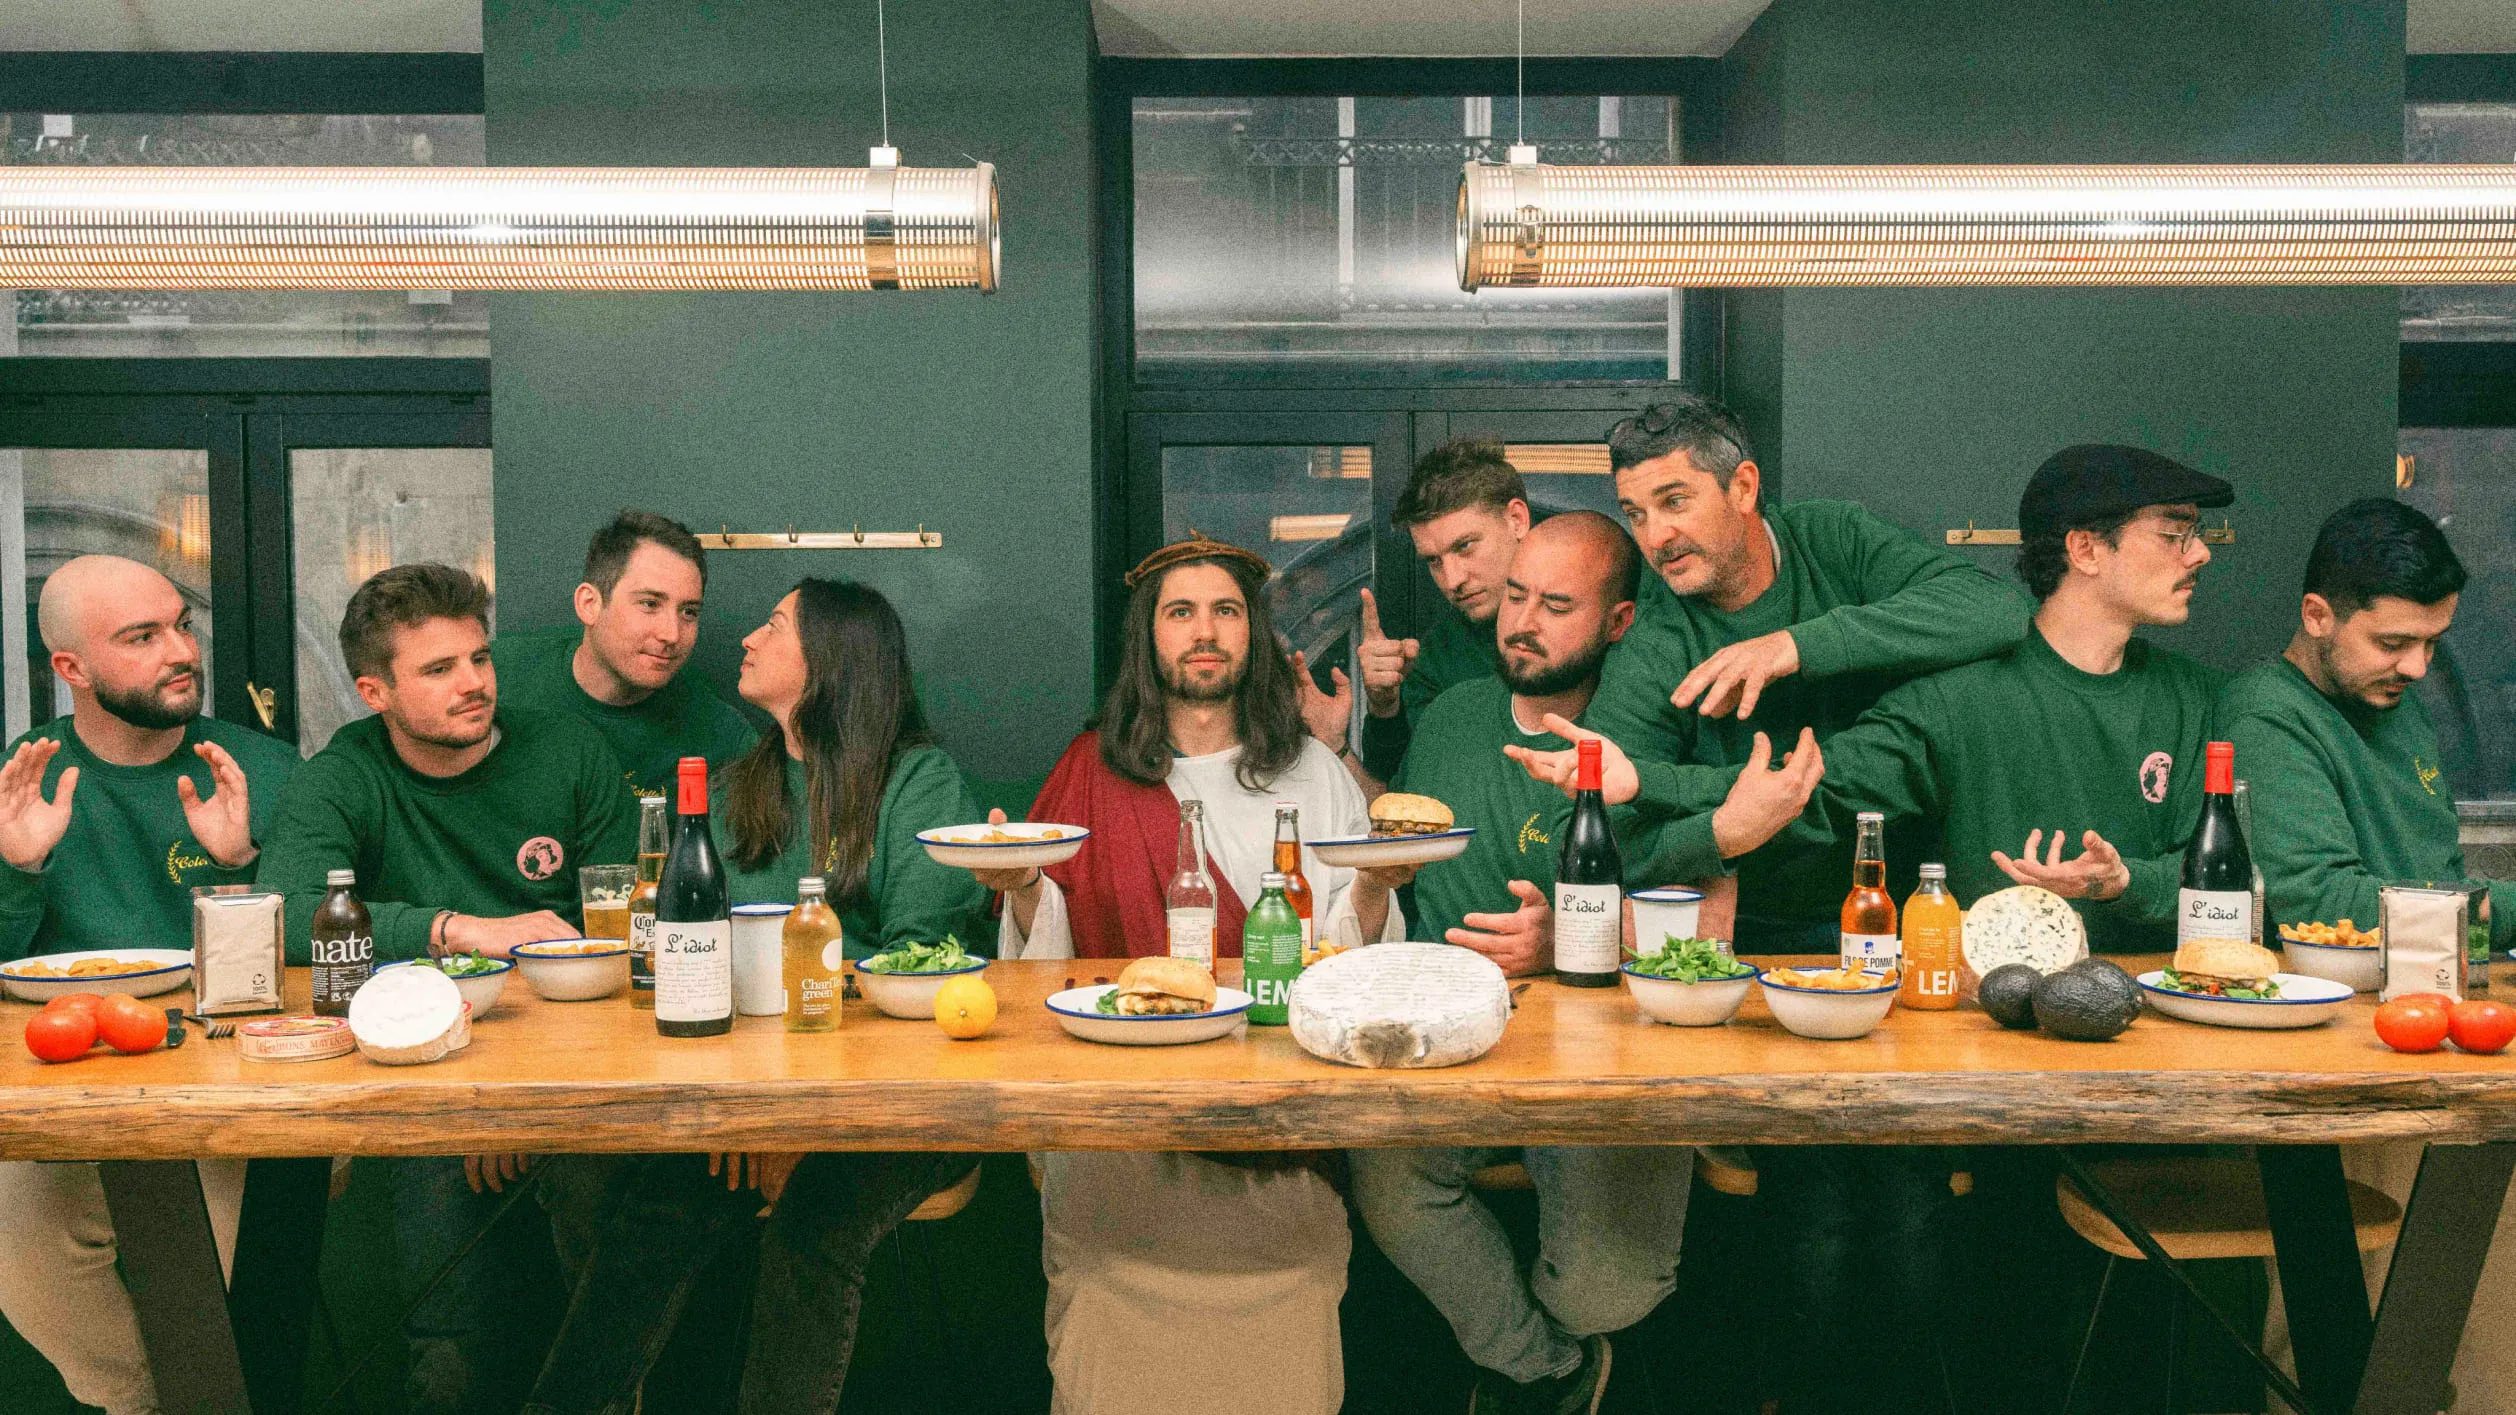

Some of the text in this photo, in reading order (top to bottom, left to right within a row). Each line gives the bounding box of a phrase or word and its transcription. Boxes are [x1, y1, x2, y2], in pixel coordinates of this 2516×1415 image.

[1562, 894, 1606, 913] L'idiot
[2189, 900, 2240, 920] L'idiot
[664, 933, 718, 954] L'idiot
[1870, 957, 1894, 968] POMME
[802, 989, 833, 1002] green
